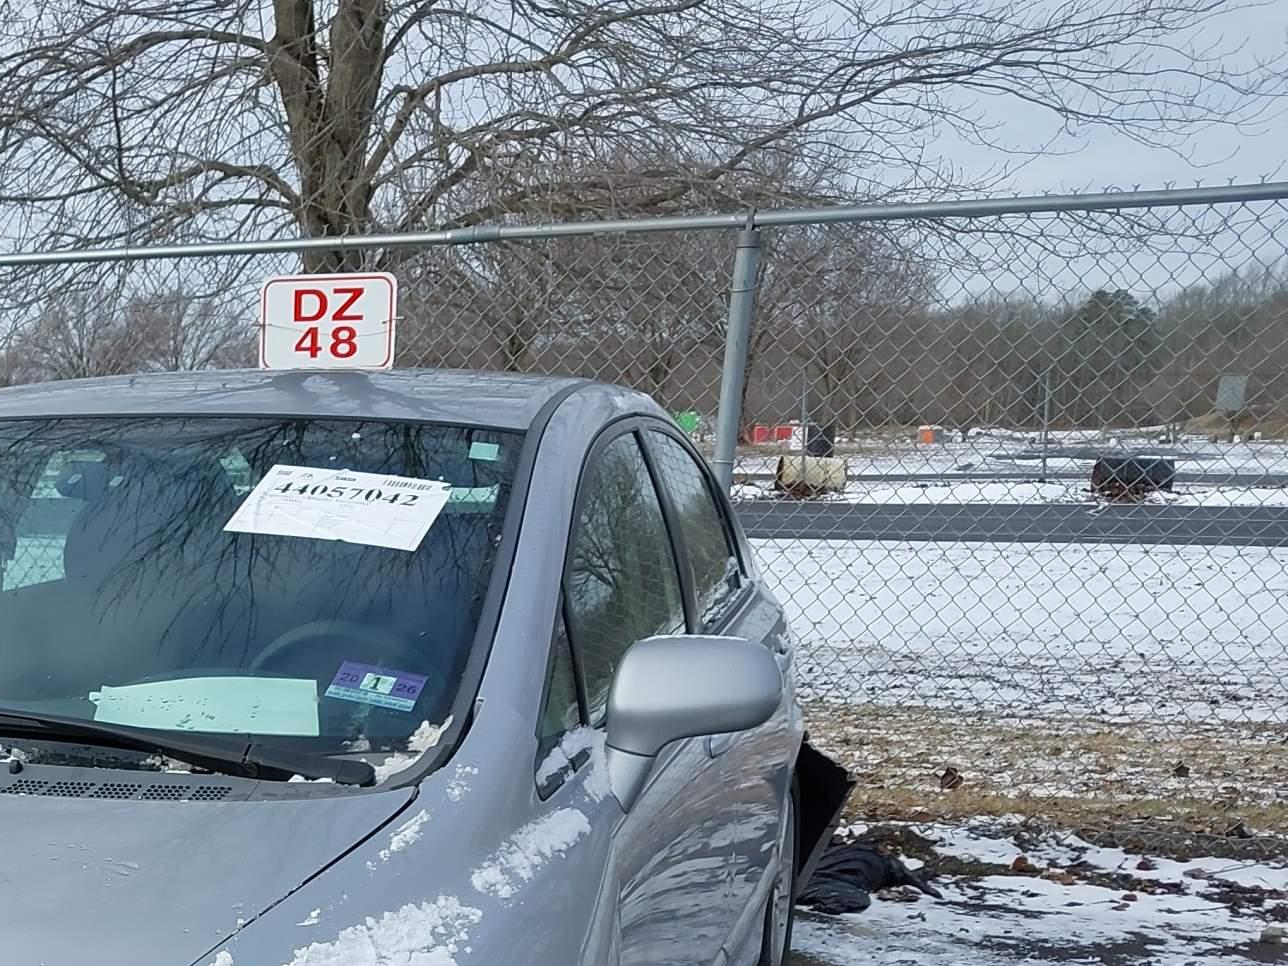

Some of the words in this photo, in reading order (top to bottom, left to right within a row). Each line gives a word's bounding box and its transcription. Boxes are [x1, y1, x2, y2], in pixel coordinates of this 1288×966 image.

[294, 288, 364, 322] DZ
[294, 326, 357, 358] 48
[274, 481, 420, 507] 44057042
[339, 672, 360, 683] 20
[369, 676, 382, 691] 1
[395, 683, 417, 695] 26
